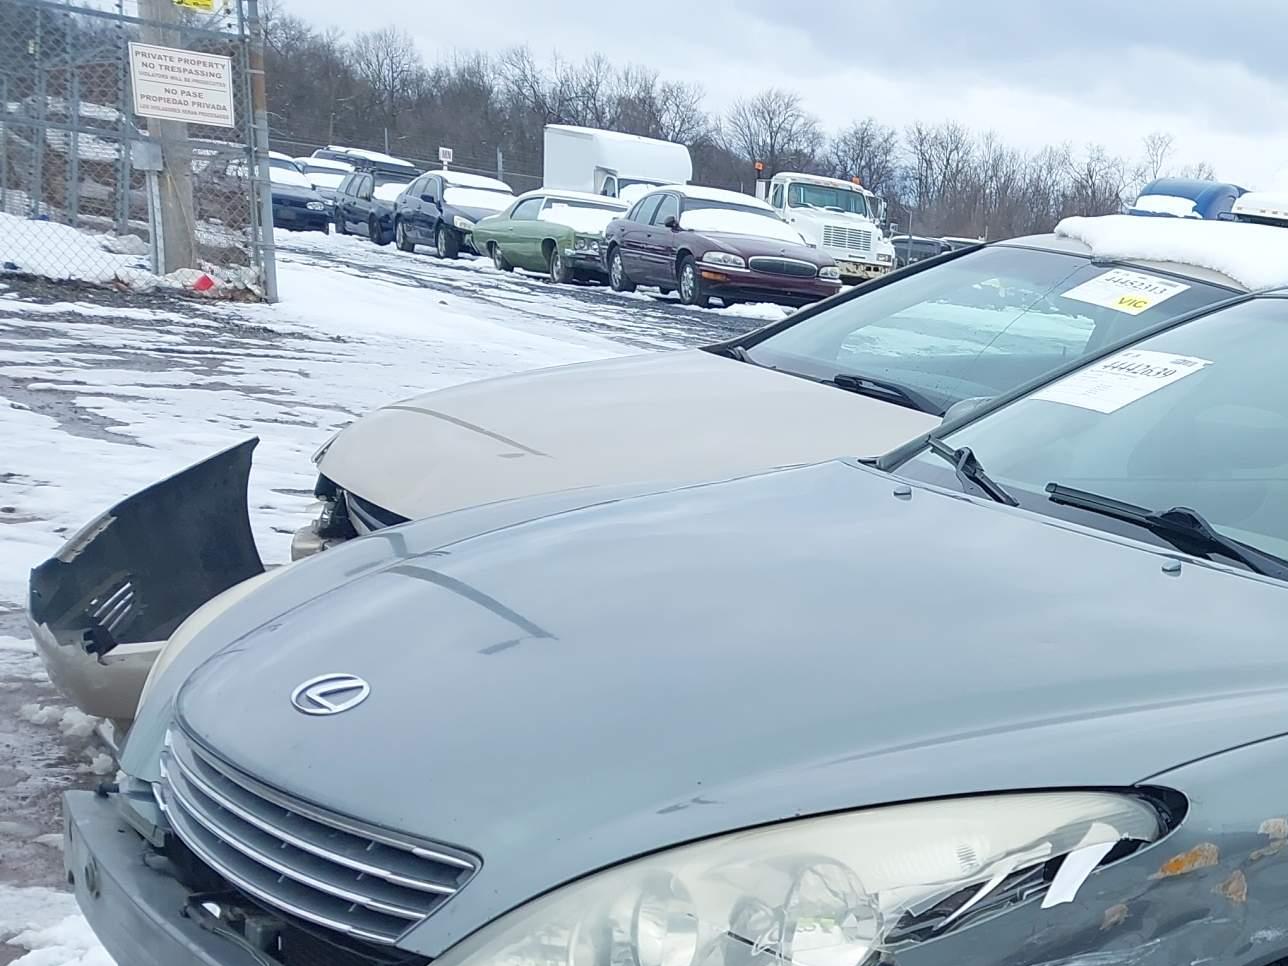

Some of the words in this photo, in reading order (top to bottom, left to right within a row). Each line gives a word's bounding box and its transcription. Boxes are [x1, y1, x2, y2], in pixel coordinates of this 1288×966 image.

[135, 50, 175, 63] PRIVATE
[177, 57, 226, 70] PROPERTY
[141, 61, 155, 69] NO
[158, 63, 223, 79] TRESPASSING
[164, 87, 178, 95] NO
[181, 89, 204, 99] PASE
[140, 94, 189, 106] PROPIEDAD
[191, 101, 228, 111] PRIVADA
[1118, 297, 1148, 309] VIC
